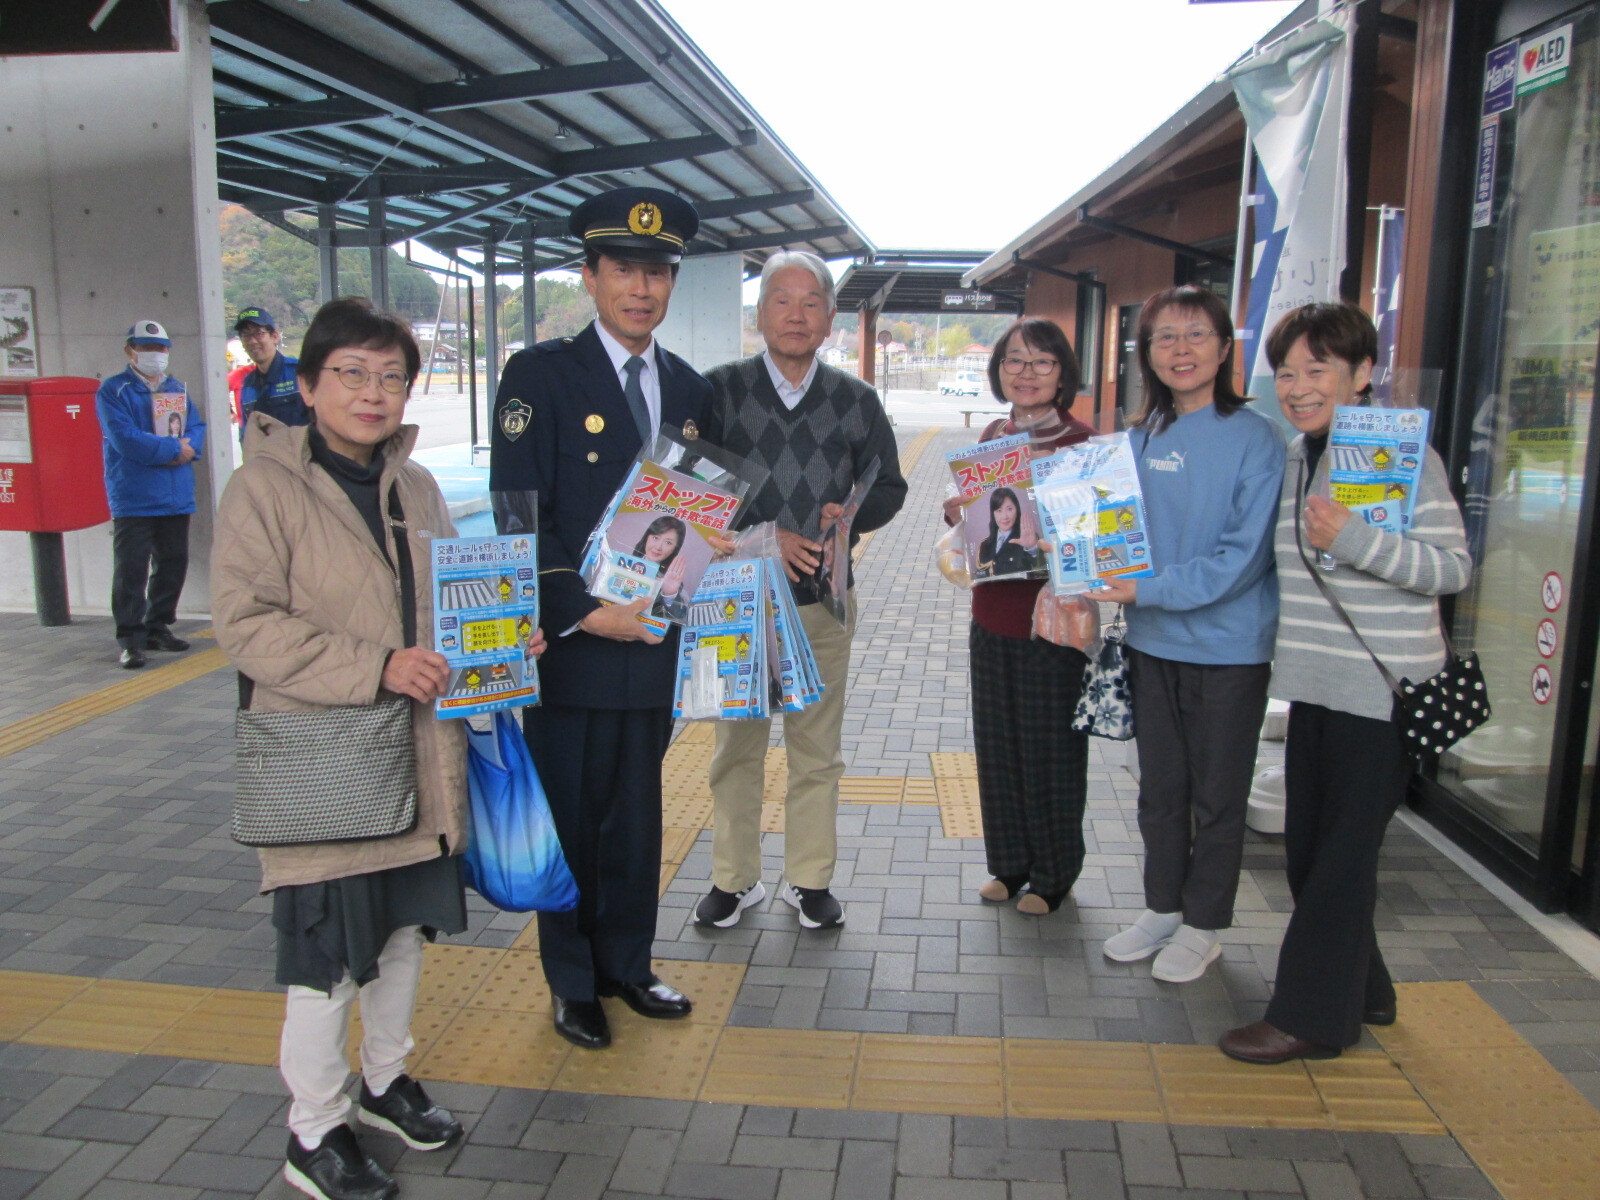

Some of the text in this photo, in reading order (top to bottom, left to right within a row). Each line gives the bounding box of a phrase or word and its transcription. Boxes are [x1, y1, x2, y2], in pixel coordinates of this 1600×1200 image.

[1537, 36, 1565, 67] AED
[0, 492, 15, 503] OST
[634, 475, 739, 517] ストップ!
[626, 495, 727, 529] 海外からの詐欺電話
[437, 542, 507, 555] 交通ルールを守って
[437, 551, 532, 565] 安全に道路を横断しましょう!
